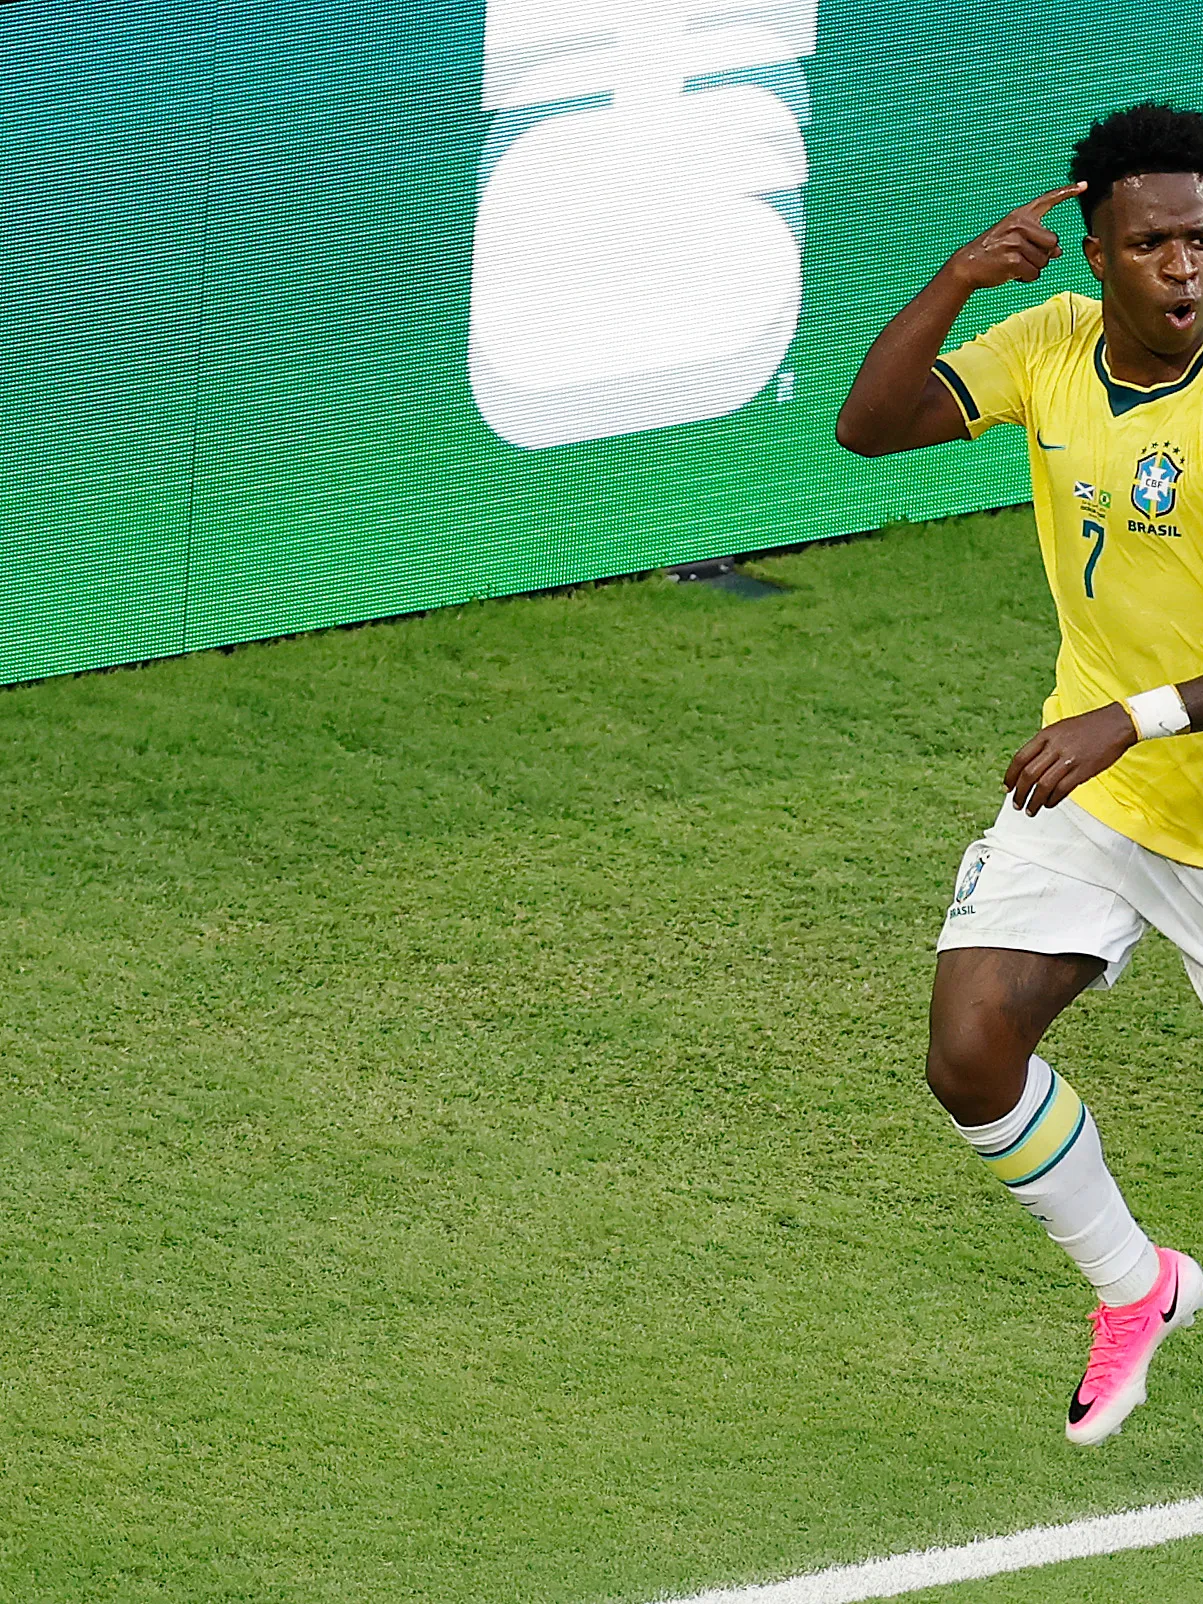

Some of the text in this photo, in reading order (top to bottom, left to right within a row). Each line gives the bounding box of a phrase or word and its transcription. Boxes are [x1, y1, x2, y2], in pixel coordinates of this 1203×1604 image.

[1145, 478, 1163, 489] CBF
[1127, 520, 1182, 537] BRASIL
[1082, 519, 1105, 599] 7
